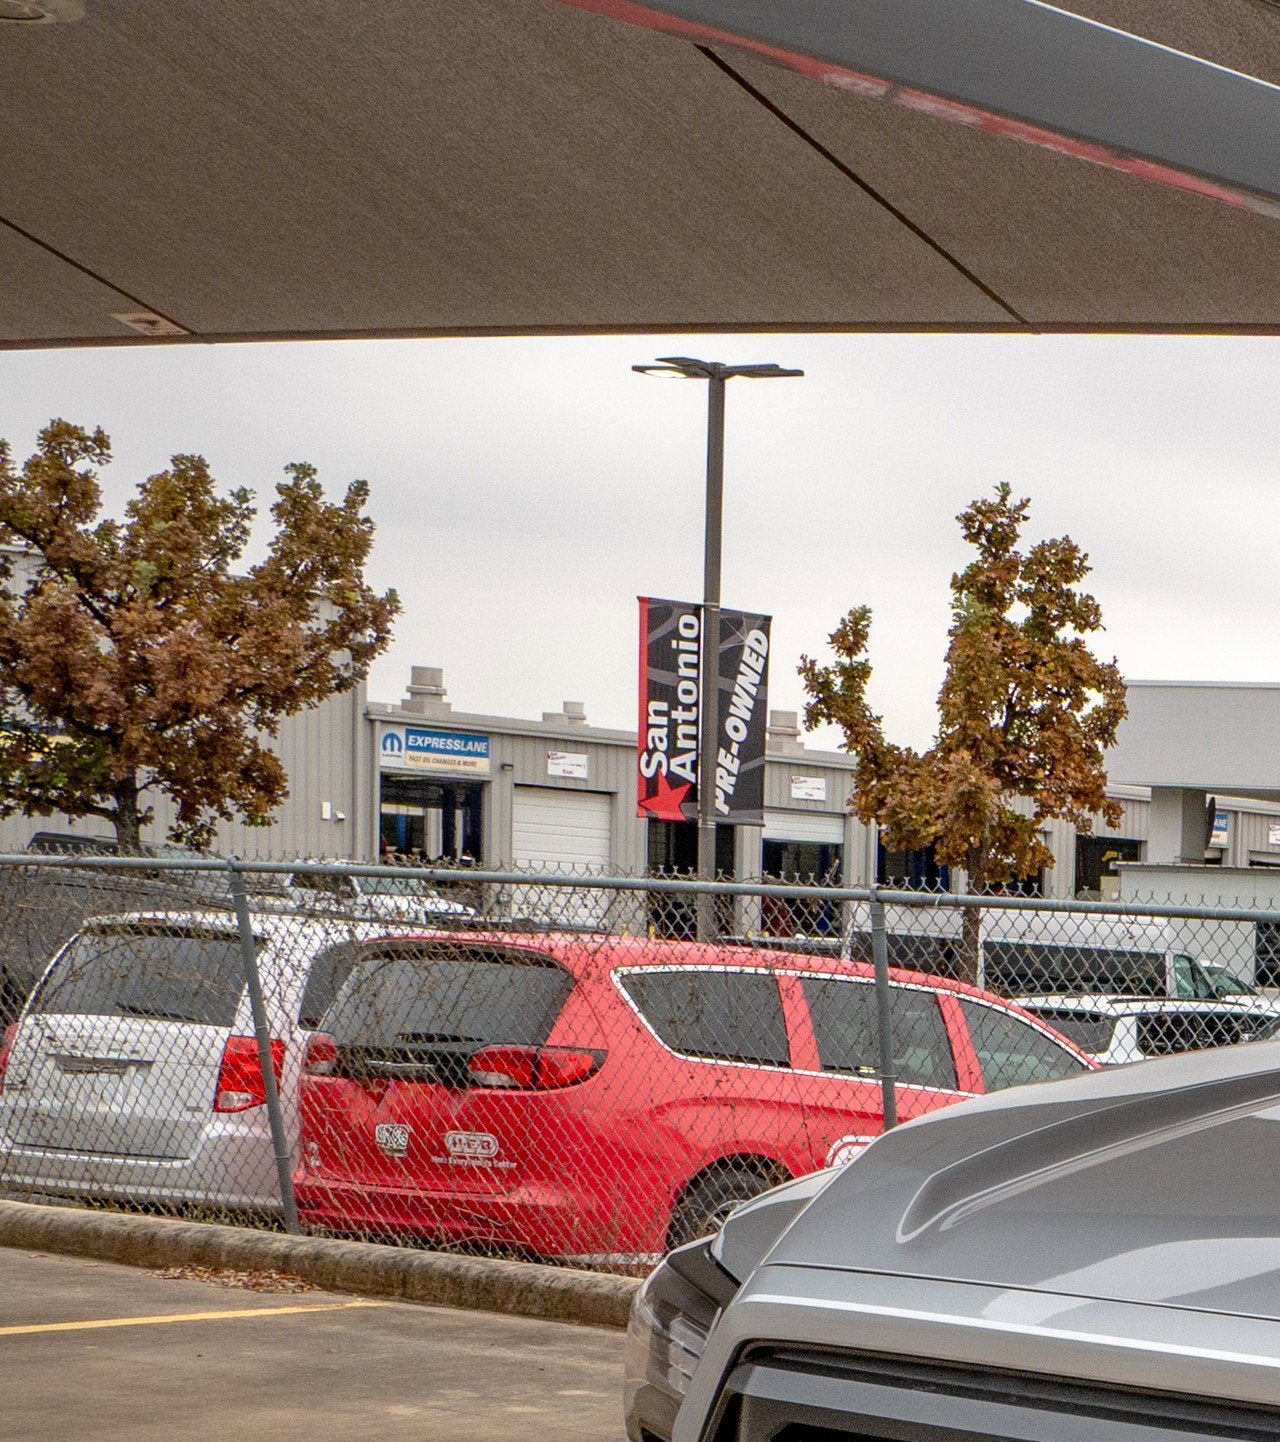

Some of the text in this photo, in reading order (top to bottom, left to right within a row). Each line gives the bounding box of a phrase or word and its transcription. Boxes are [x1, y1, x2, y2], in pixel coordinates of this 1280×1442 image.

[408, 735, 488, 753] EXPRESSLANE
[640, 700, 668, 779] San
[670, 614, 700, 784] Antonio
[715, 628, 769, 815] PRE-OWNED
